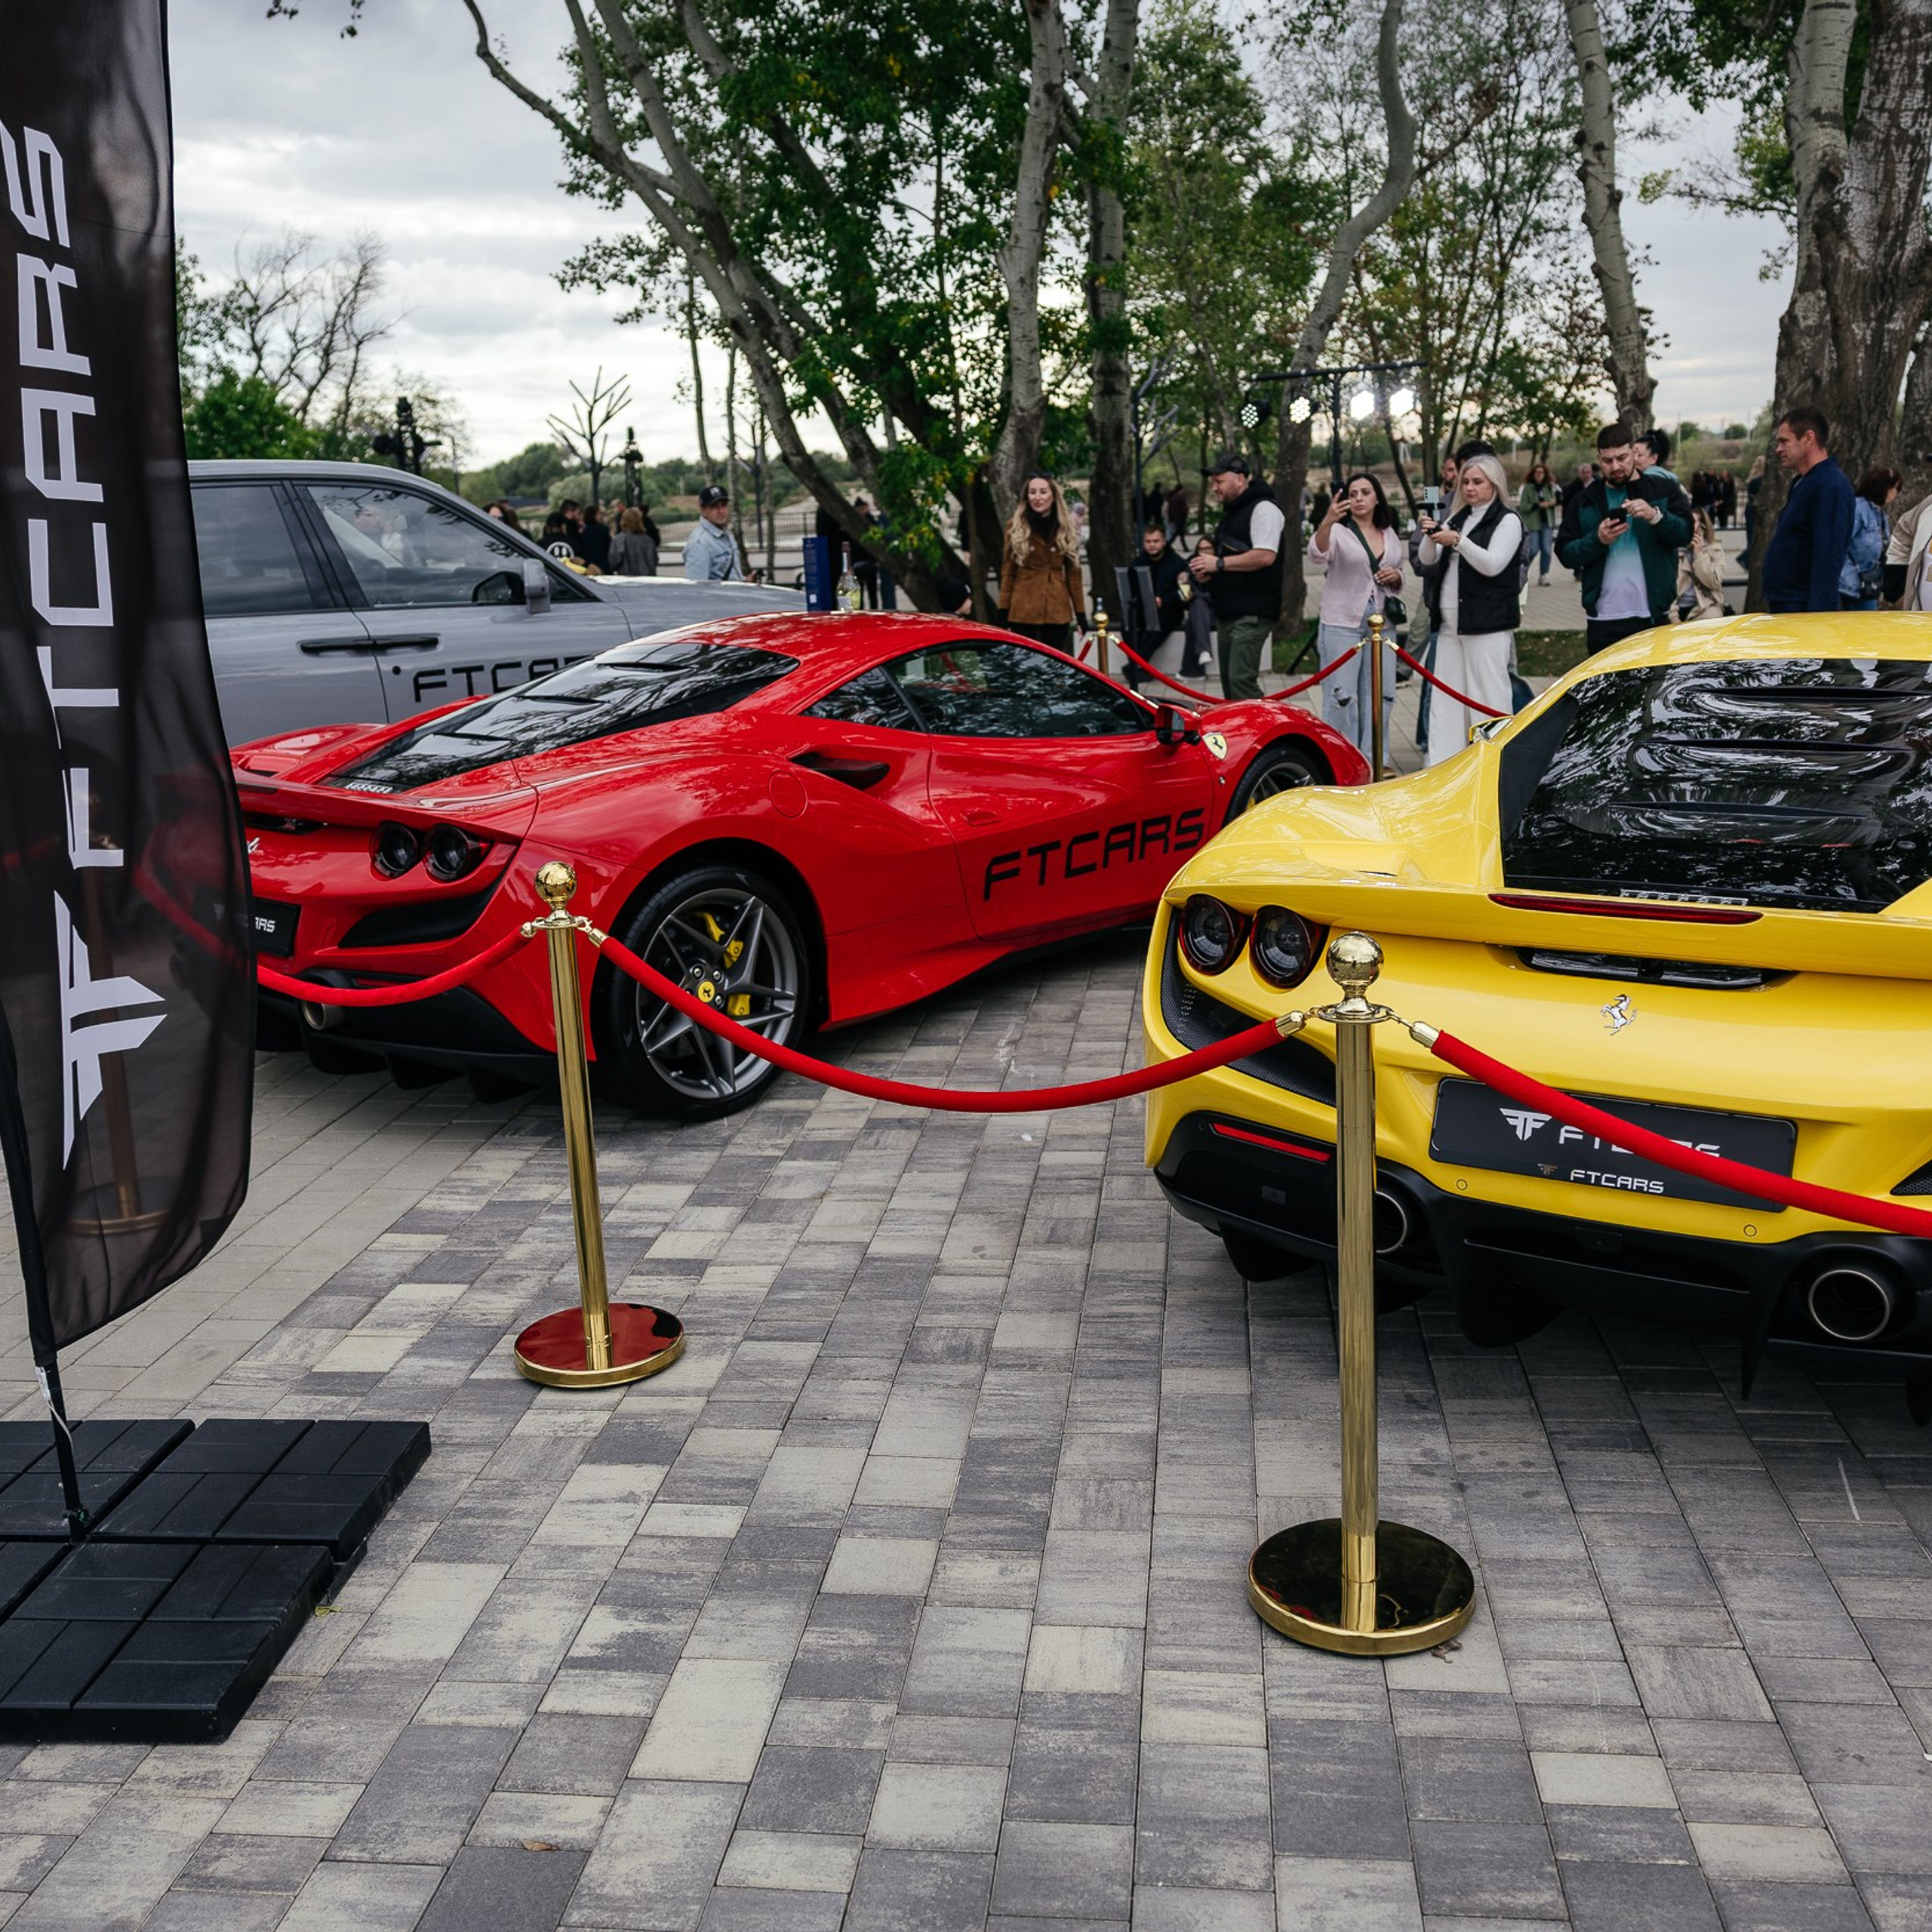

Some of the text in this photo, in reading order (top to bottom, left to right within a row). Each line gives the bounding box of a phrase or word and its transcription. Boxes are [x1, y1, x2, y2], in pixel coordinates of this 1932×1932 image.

[413, 654, 592, 703] FTCA
[983, 807, 1205, 901] FTCARS
[1570, 1169, 1664, 1194] FTCARS
